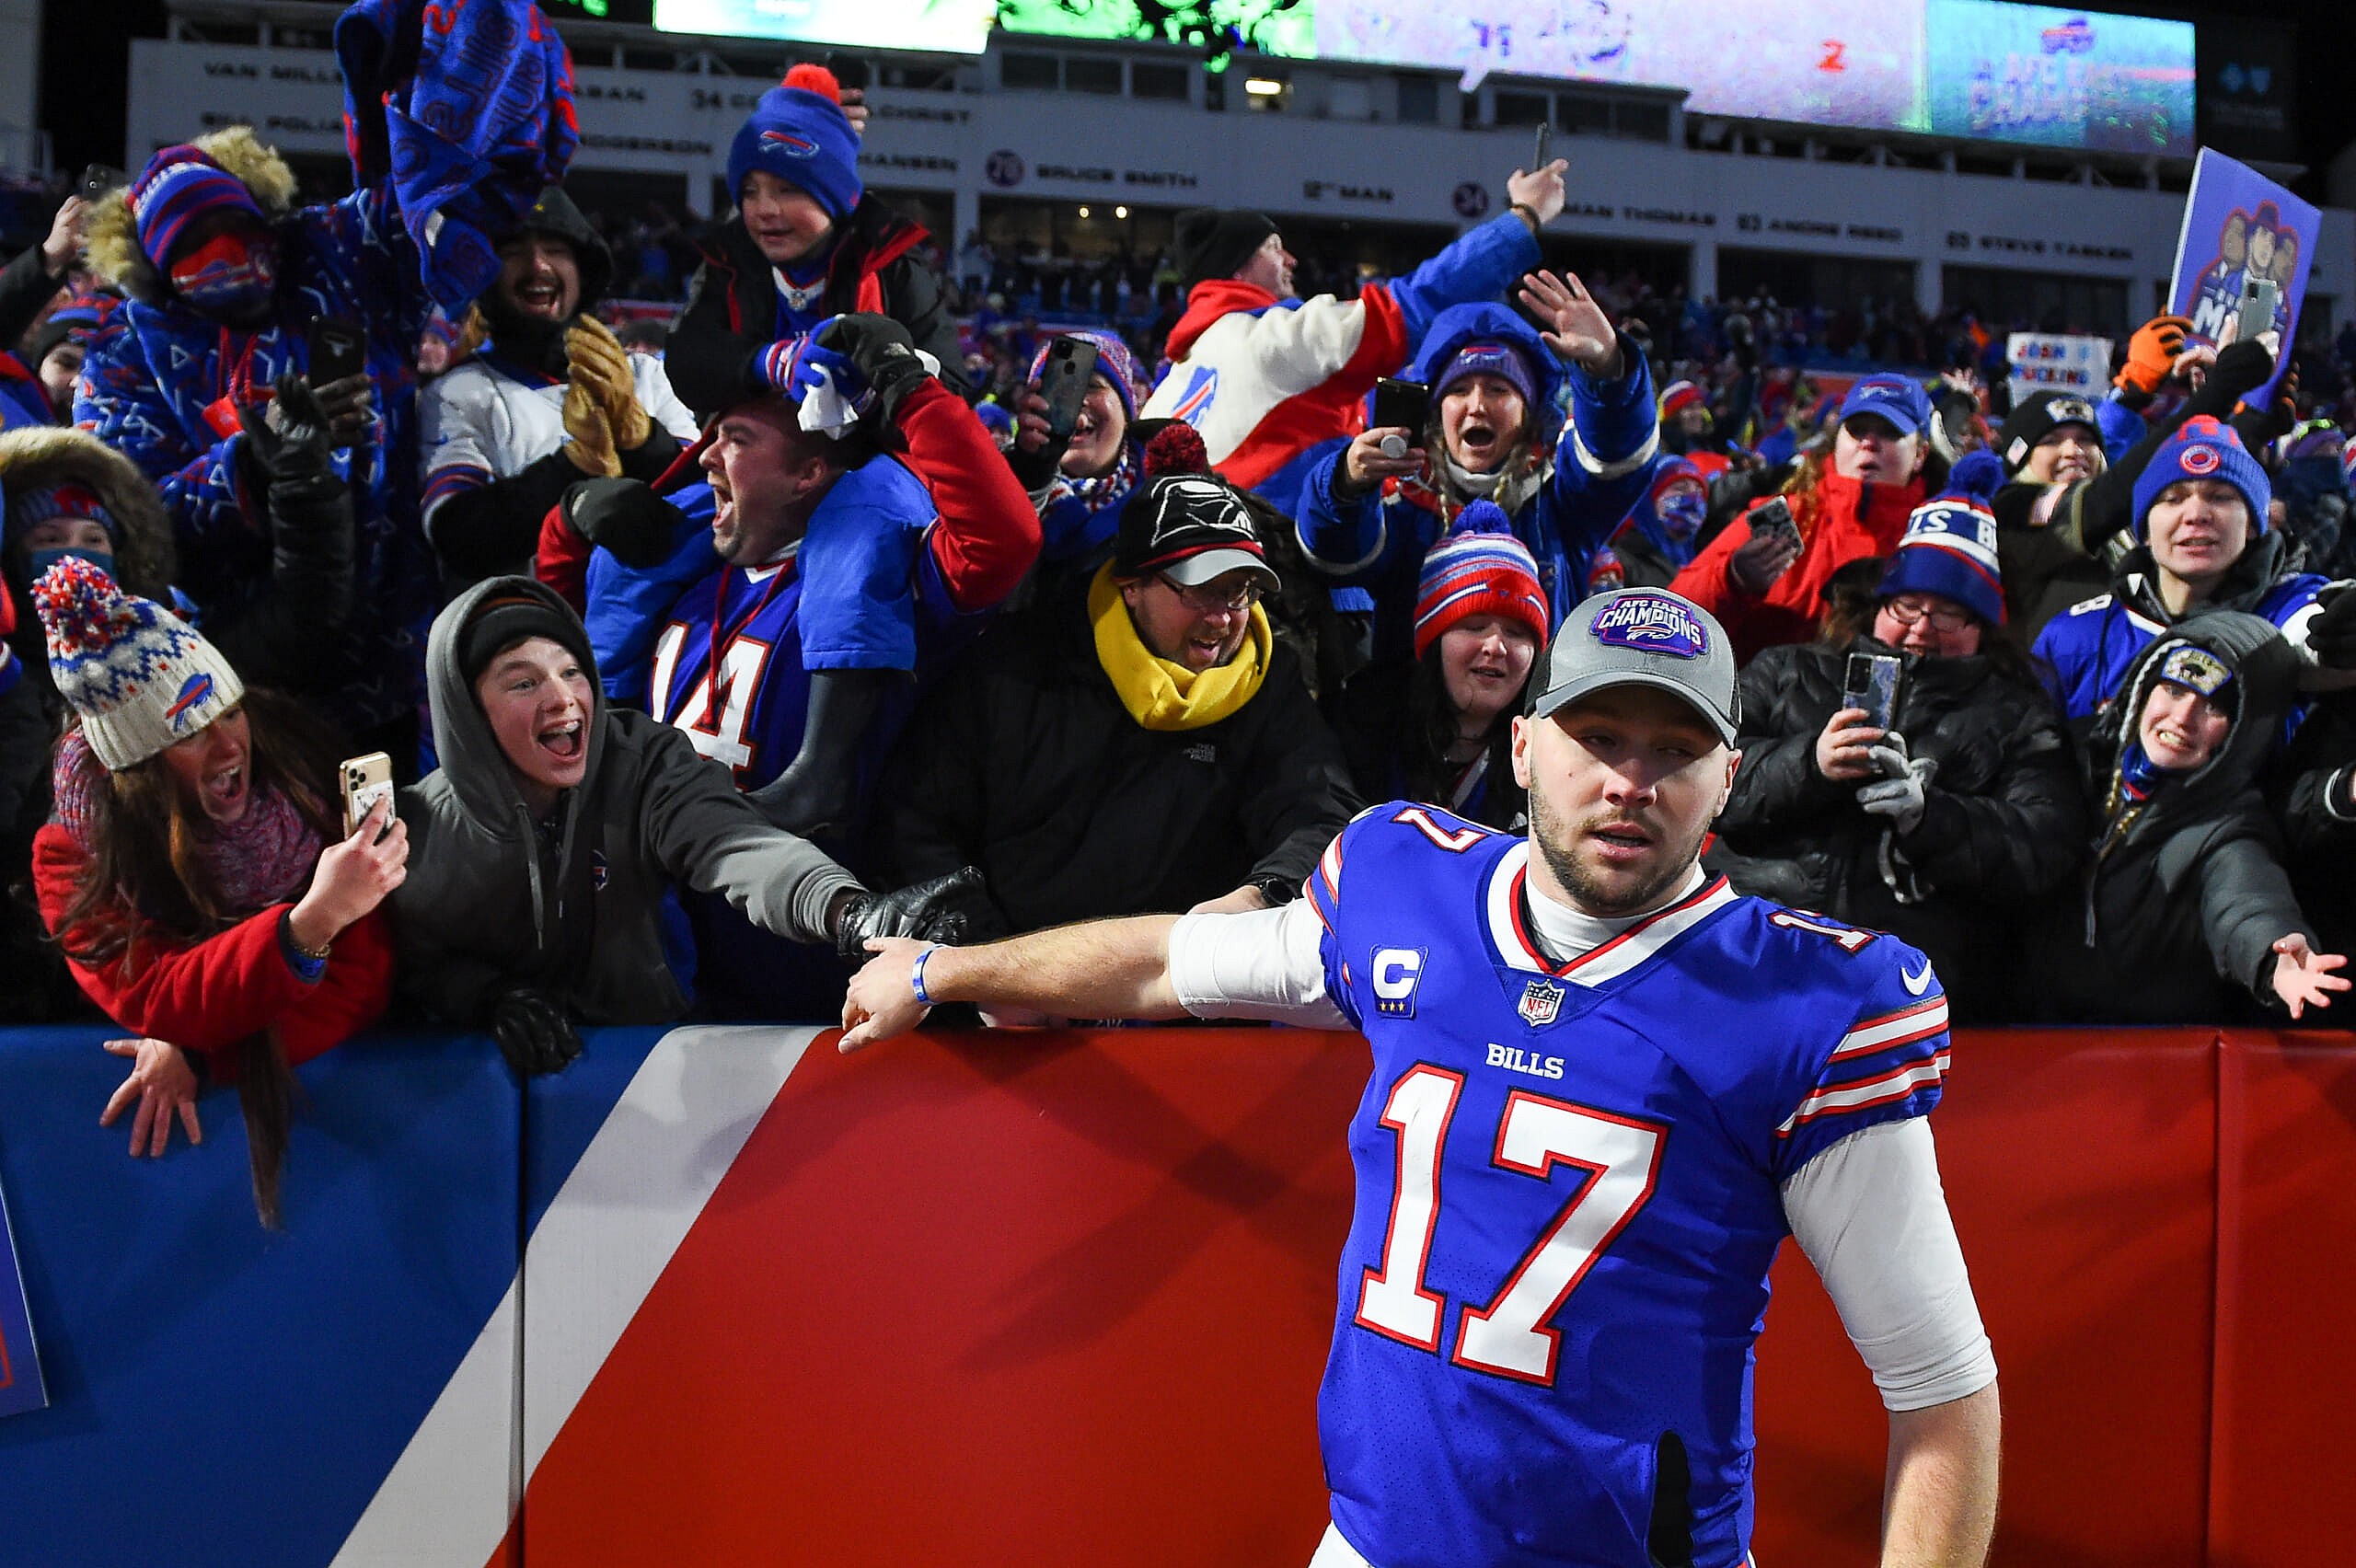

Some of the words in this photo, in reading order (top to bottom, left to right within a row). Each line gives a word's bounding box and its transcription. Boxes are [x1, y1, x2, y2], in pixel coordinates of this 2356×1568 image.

[1597, 607, 1702, 646] CHAMPIONS
[1619, 600, 1649, 608] AFC
[1651, 600, 1687, 618] EAST
[651, 619, 769, 773] 14
[1392, 802, 1504, 853] 7
[1771, 905, 1887, 953] 1
[1372, 949, 1421, 999] C
[1525, 997, 1552, 1019] NFL
[1485, 1042, 1566, 1080] BILLS
[1355, 1061, 1670, 1388] 17
